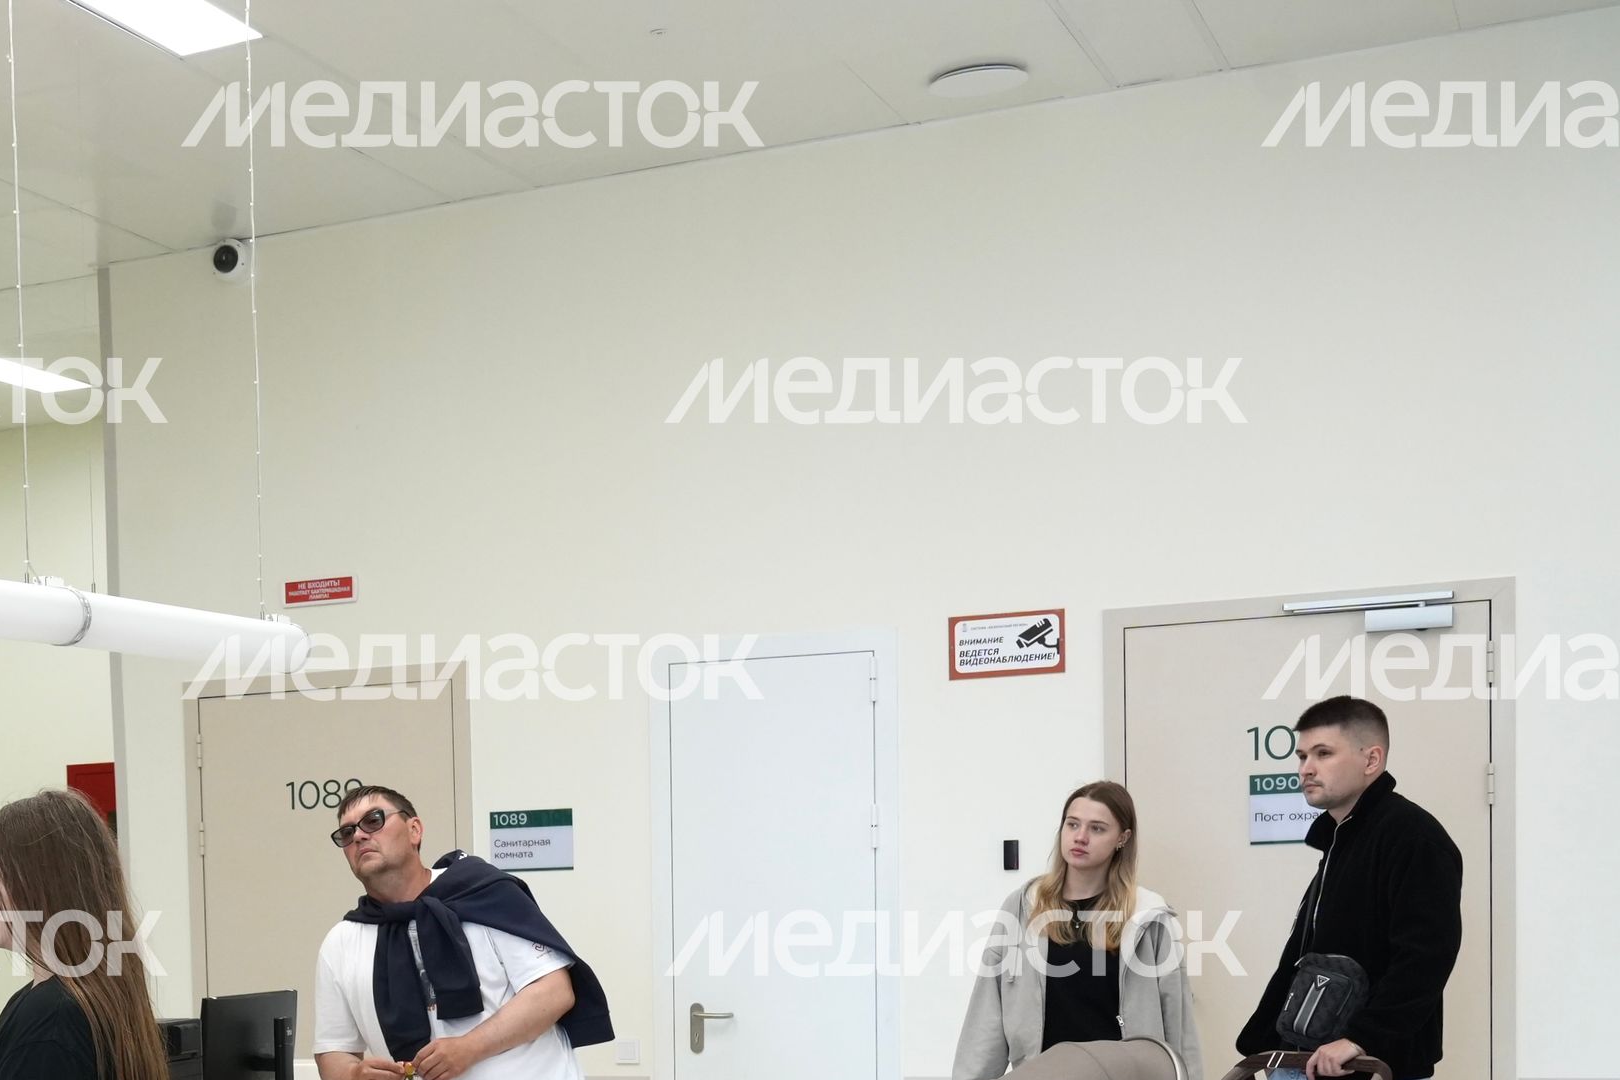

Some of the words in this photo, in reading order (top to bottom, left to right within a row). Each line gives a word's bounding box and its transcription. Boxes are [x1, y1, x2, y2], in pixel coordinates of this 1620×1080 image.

[958, 636, 1005, 647] ВНИМАНИЕ
[959, 647, 1000, 659] ВЕДЕТСЯ
[959, 652, 1056, 668] ВИДЕОНАБЛЮДЕНИЕ!
[1253, 775, 1300, 792] 1090
[493, 812, 528, 826] 1089
[1254, 812, 1285, 822] Пост
[1288, 811, 1323, 822] охра
[494, 838, 551, 848] Санитарная
[494, 850, 533, 860] комната
